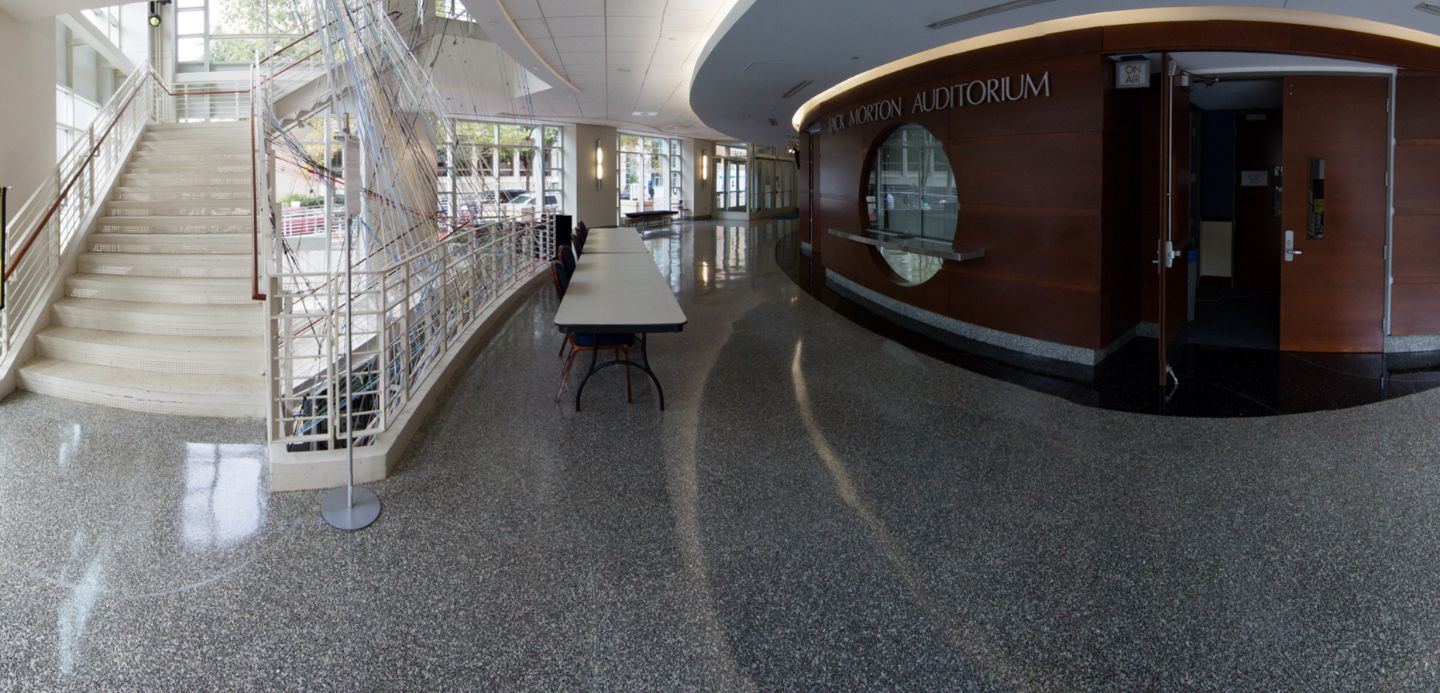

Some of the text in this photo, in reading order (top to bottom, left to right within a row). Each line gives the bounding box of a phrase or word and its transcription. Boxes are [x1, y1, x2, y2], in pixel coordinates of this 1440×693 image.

[1125, 64, 1142, 74] ON
[1125, 74, 1141, 84] AIR
[849, 96, 903, 127] MORTON
[912, 71, 1050, 115] AUDITORIUM
